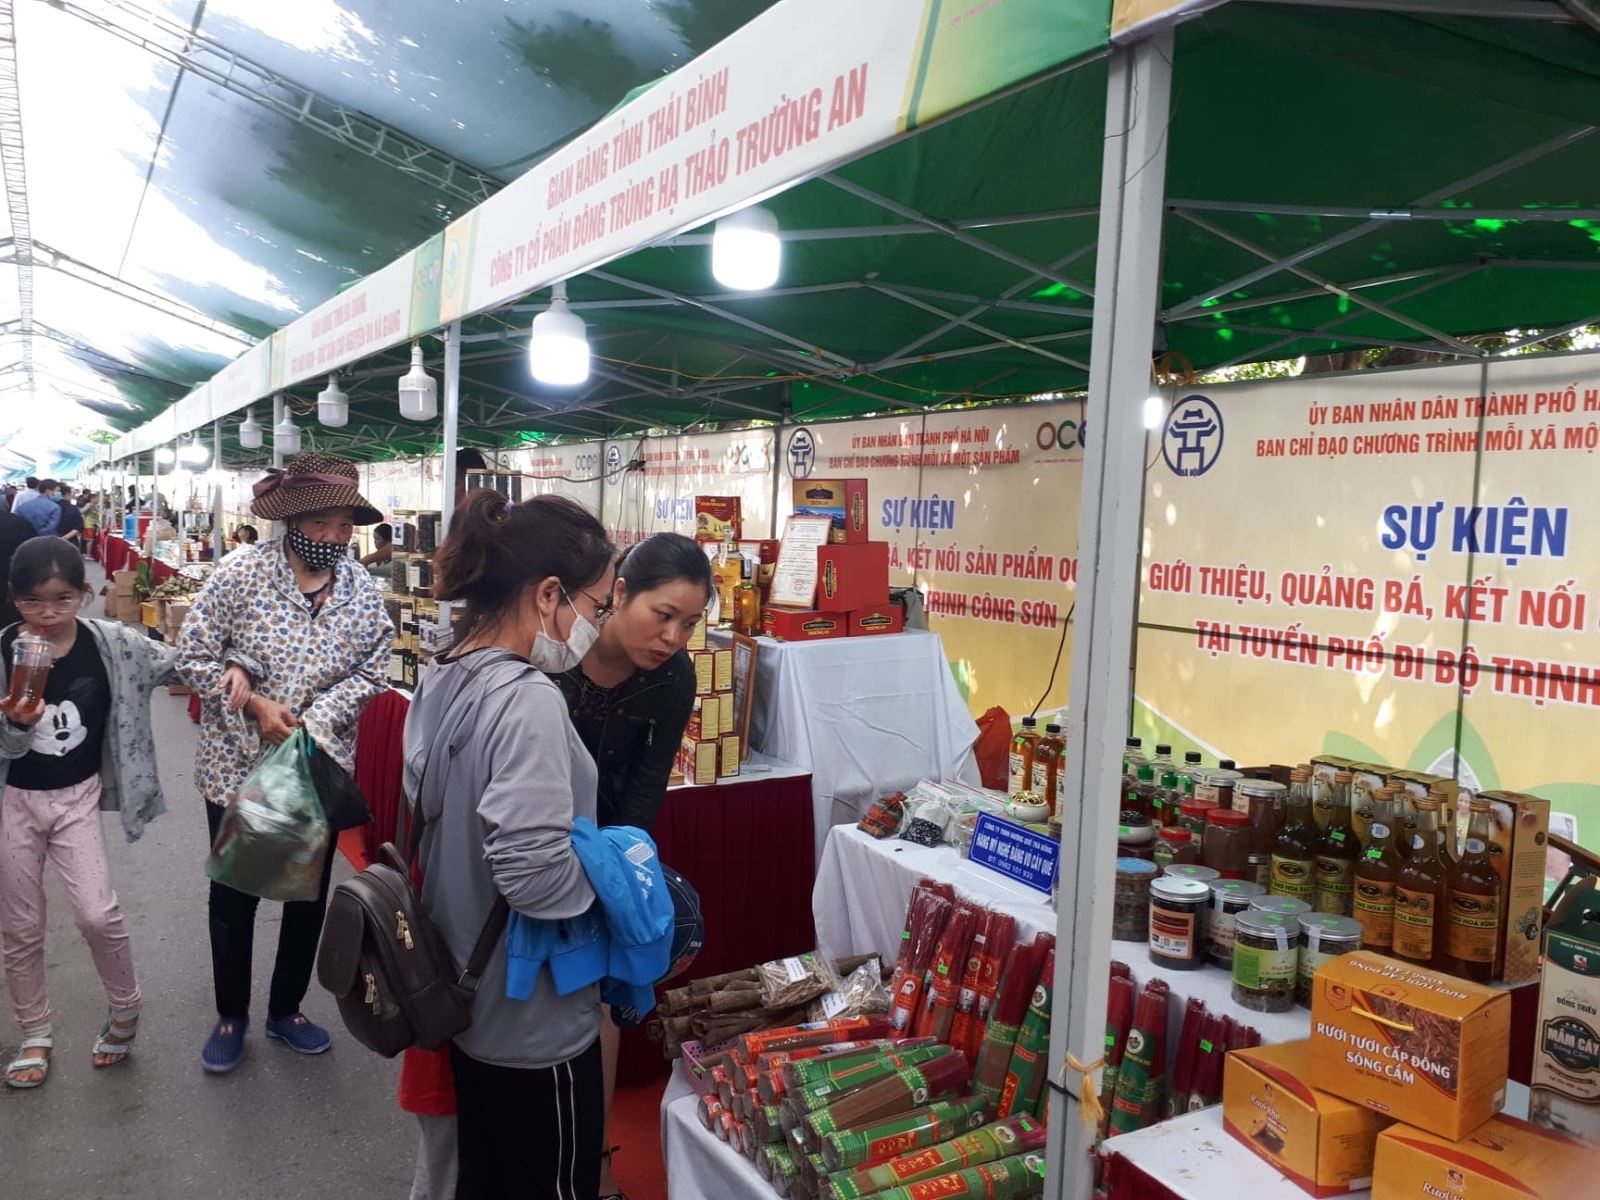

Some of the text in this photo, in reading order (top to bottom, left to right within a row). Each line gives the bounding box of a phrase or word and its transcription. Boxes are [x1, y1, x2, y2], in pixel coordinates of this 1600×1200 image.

[547, 67, 729, 210] GIAN HÀNG TỈNH THÁI BÌNH
[490, 249, 513, 288] CÔNG
[515, 243, 526, 277] TY
[609, 178, 655, 233] TRÙNG
[657, 163, 679, 215] HẠ
[684, 128, 730, 199] THẢO
[735, 87, 822, 176] TRƯỜNG
[826, 62, 868, 133] AN
[1309, 382, 1600, 426] ỦY BAN NHÂN DÂN THÀNH PHỐ H
[961, 428, 973, 444] HÀ
[974, 426, 990, 446] NỘI
[1256, 421, 1600, 460] BAN CHỈ ĐẠO CHƯƠNG TRÌNH MỖI XÃ MỘ
[882, 497, 906, 533] SỰ
[910, 494, 955, 535] KIỆN
[1381, 496, 1568, 566] SỰ KIỆN
[888, 542, 903, 569] Á,
[907, 541, 932, 569] KẾT
[936, 543, 960, 572] NỐI
[965, 544, 997, 576] SẢN
[1002, 546, 1053, 581] PHẨM
[924, 590, 1058, 628] TRỊNH CÔNG SƠN
[1149, 559, 1586, 631] GIỚI THIỆU, QUẢNG BÁ, KẾT NỐI
[1195, 620, 1600, 706] TẠI TUYẾN PHỐ ĐI BỘ TRỊNH
[1317, 1022, 1347, 1043] RƯƠI
[1350, 1033, 1380, 1054] TƯƠI
[1411, 1056, 1450, 1079] ĐÔNG
[1346, 1051, 1382, 1073] SÔNG
